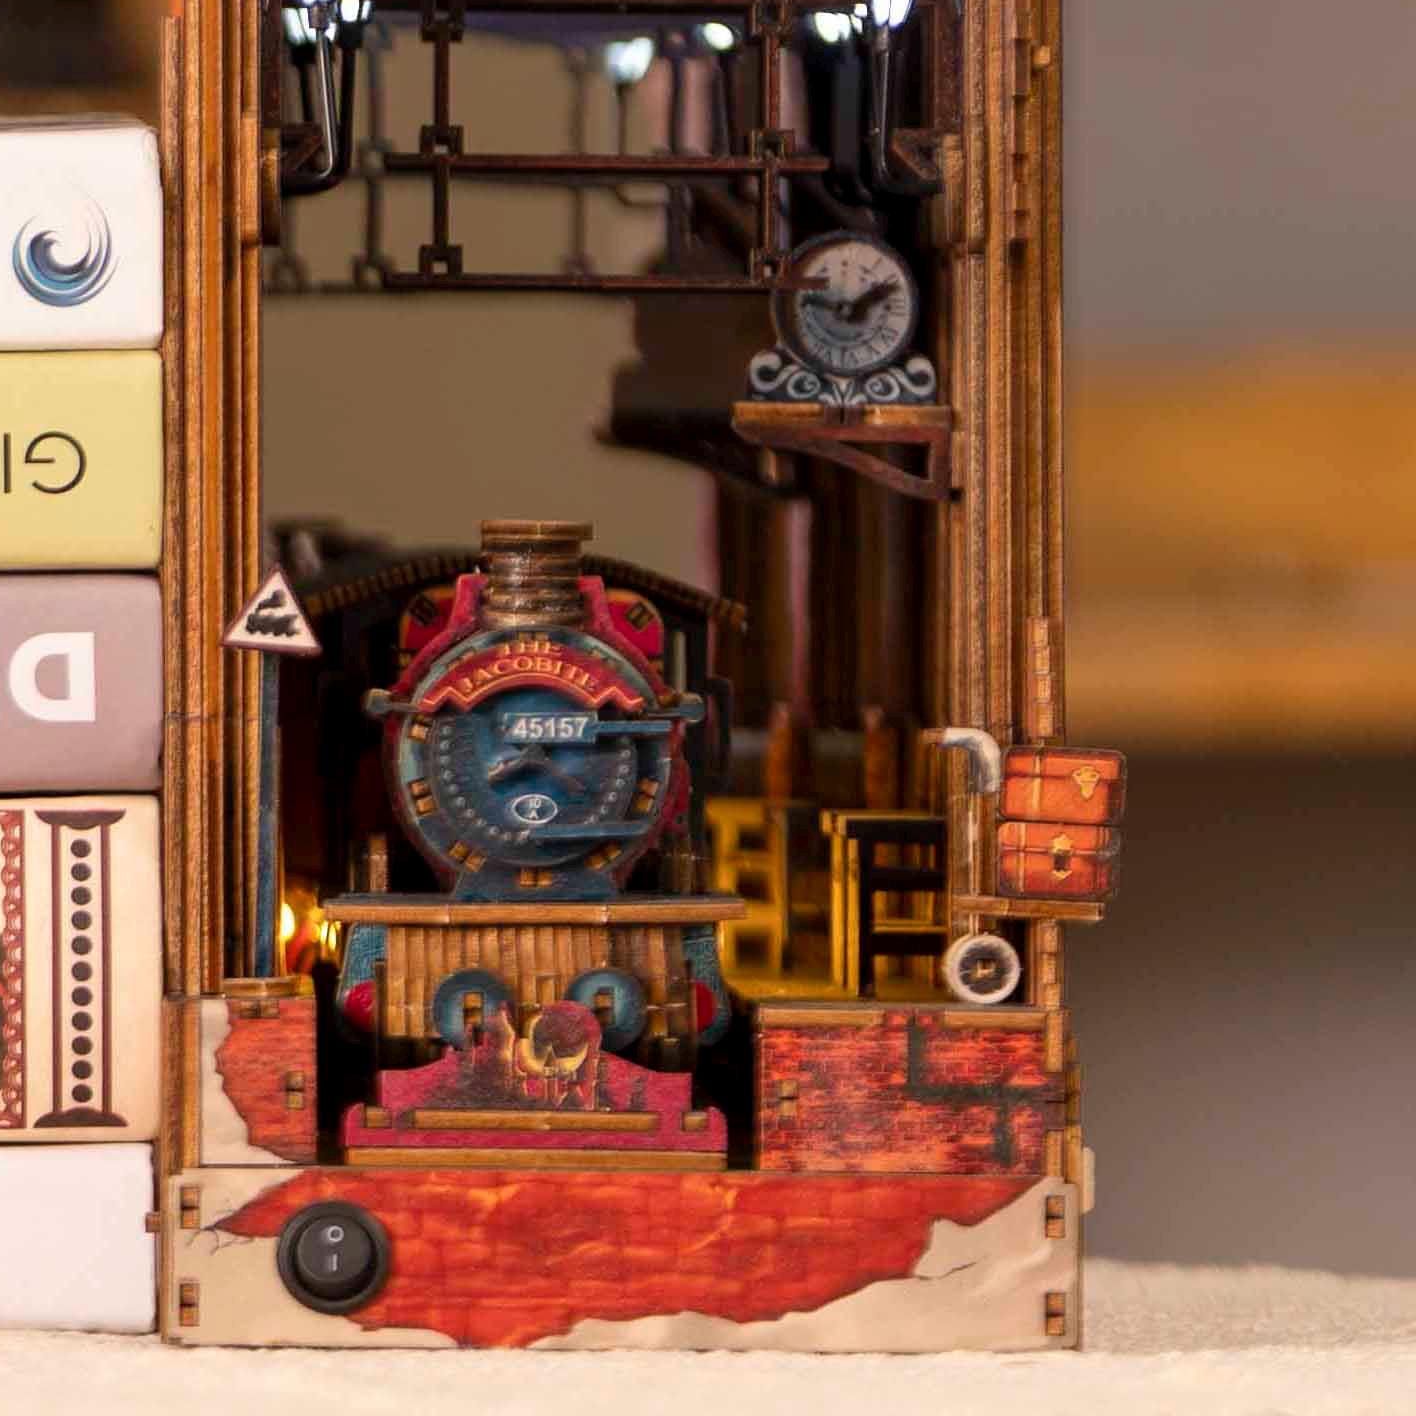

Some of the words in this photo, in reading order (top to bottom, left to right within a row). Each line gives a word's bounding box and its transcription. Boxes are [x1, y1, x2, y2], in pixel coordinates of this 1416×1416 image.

[497, 640, 563, 656] THE
[461, 655, 598, 692] JACOBITE
[511, 717, 589, 739] 45157
